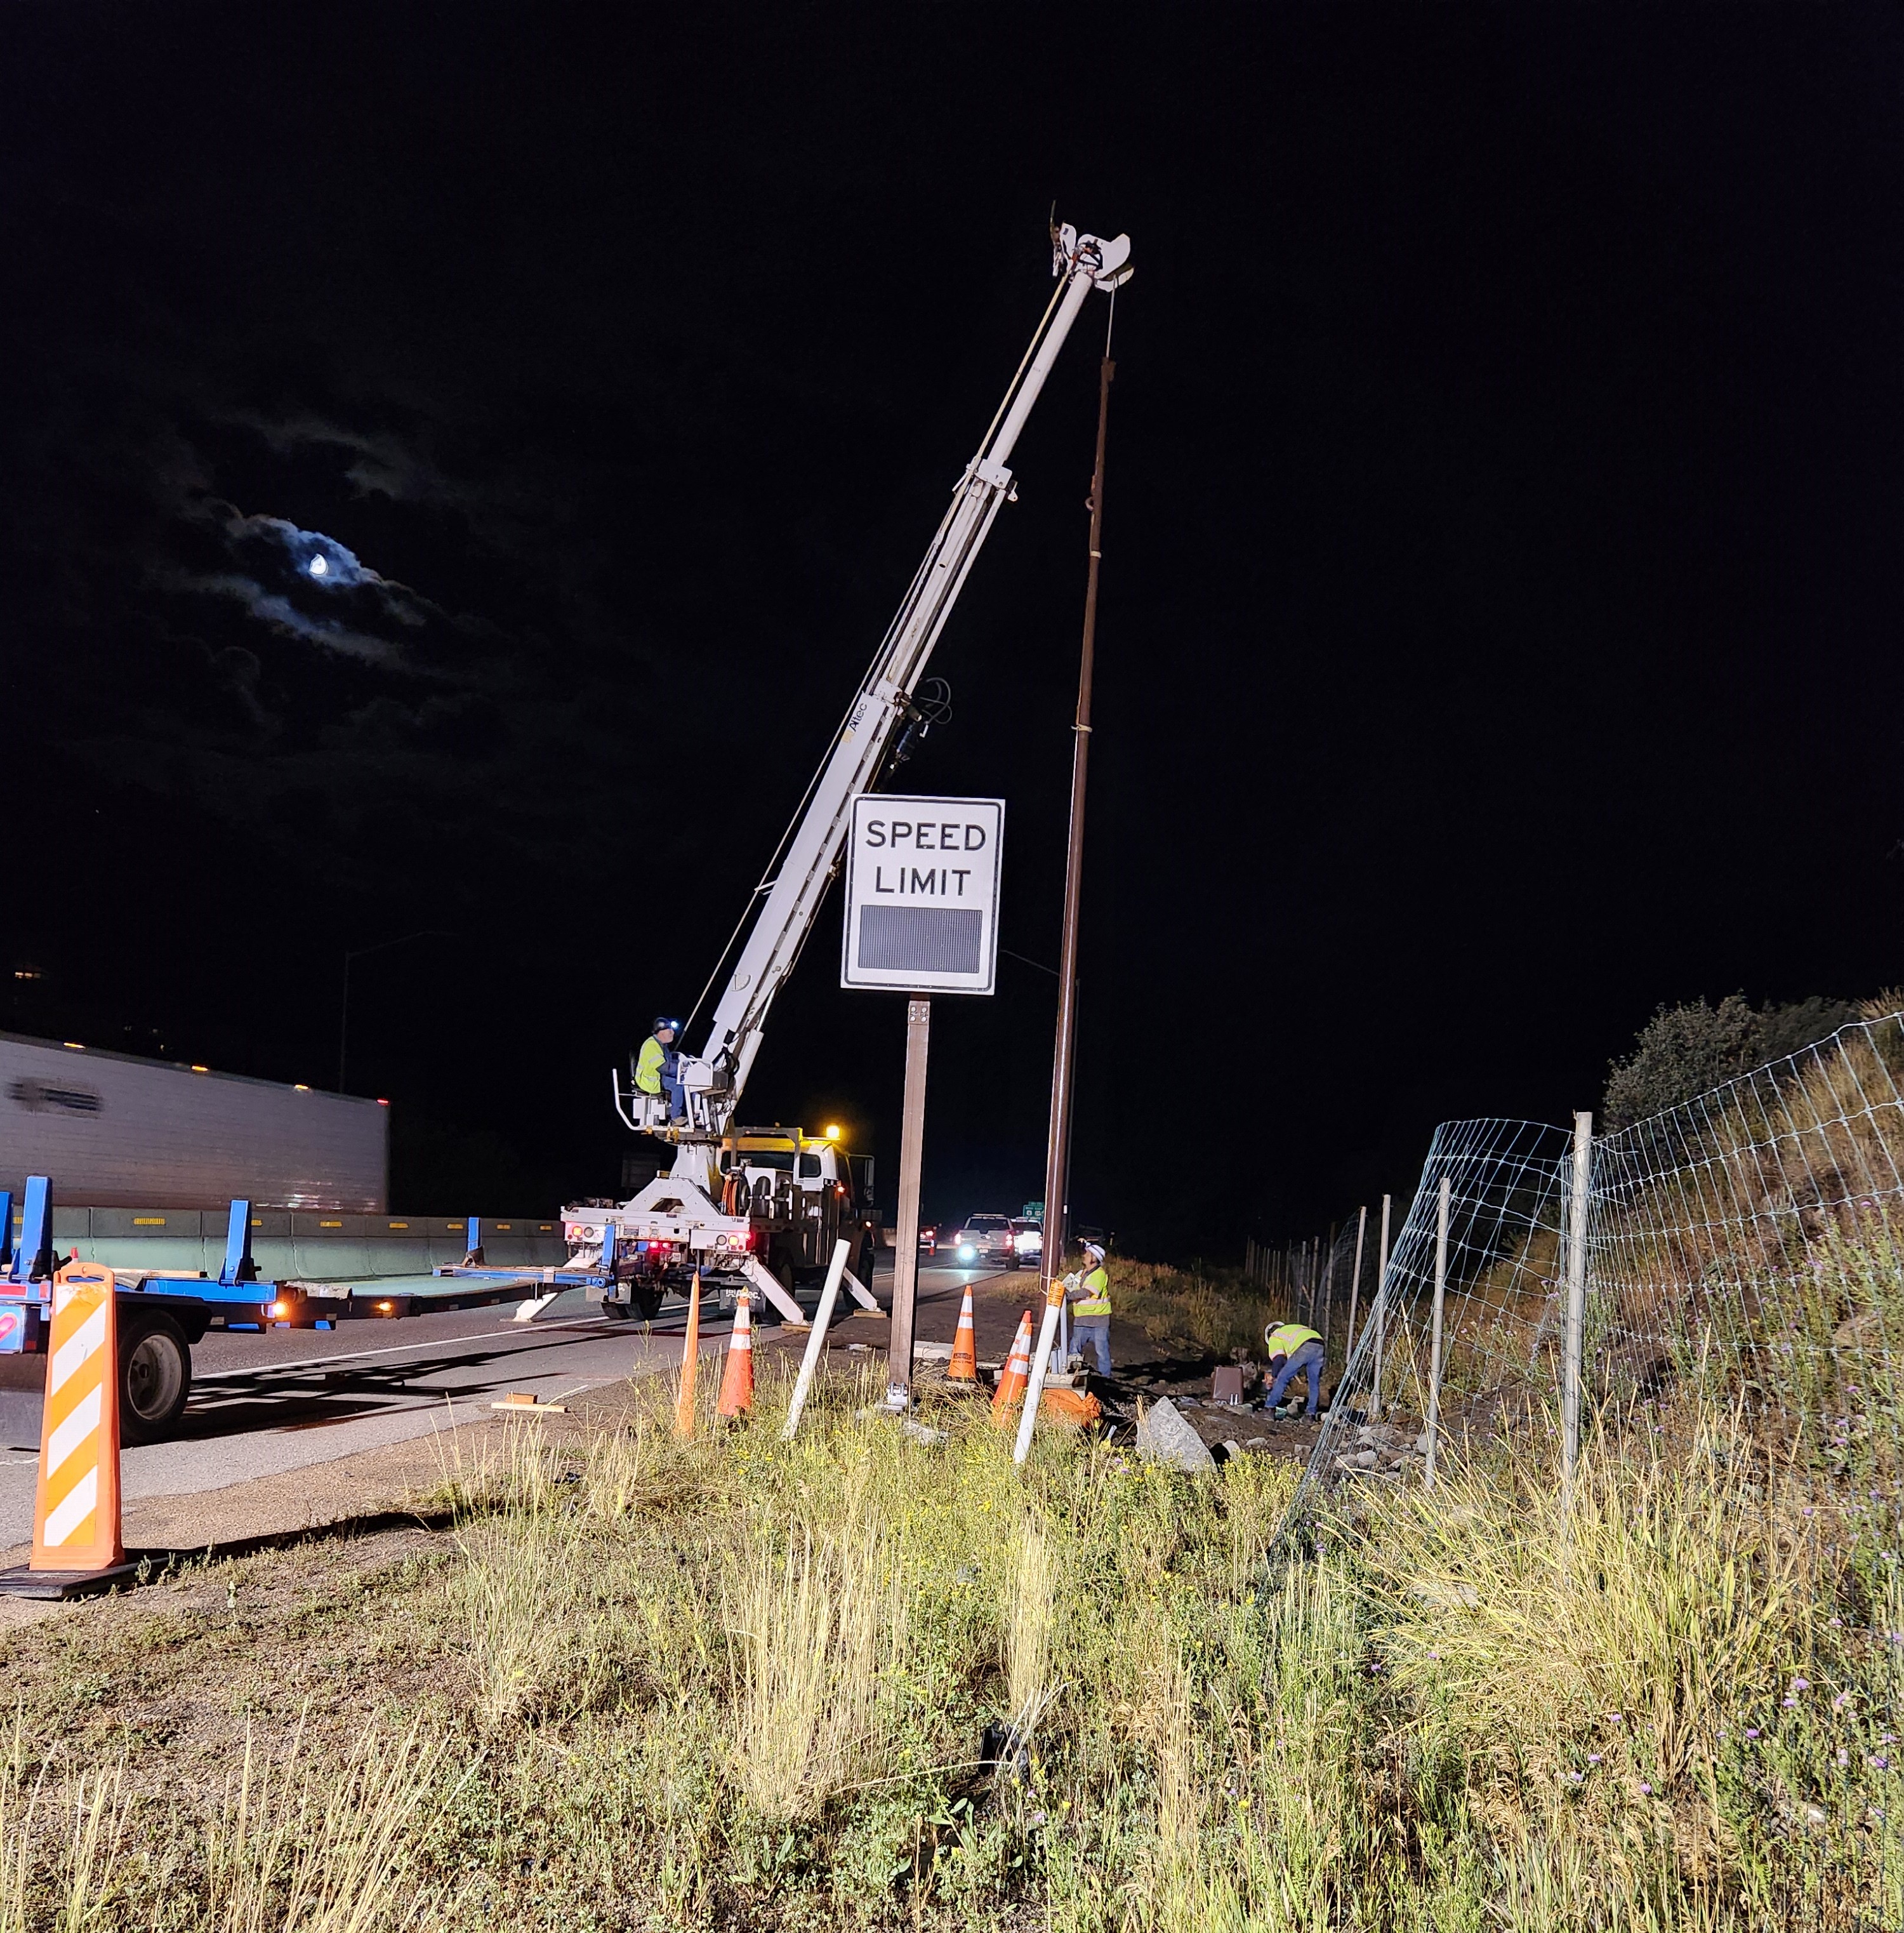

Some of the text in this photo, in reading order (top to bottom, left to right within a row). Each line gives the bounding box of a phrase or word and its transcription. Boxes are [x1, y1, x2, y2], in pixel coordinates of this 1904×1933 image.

[849, 703, 867, 733] Altec
[866, 820, 986, 851] SPEED
[875, 866, 971, 896] LIMIT
